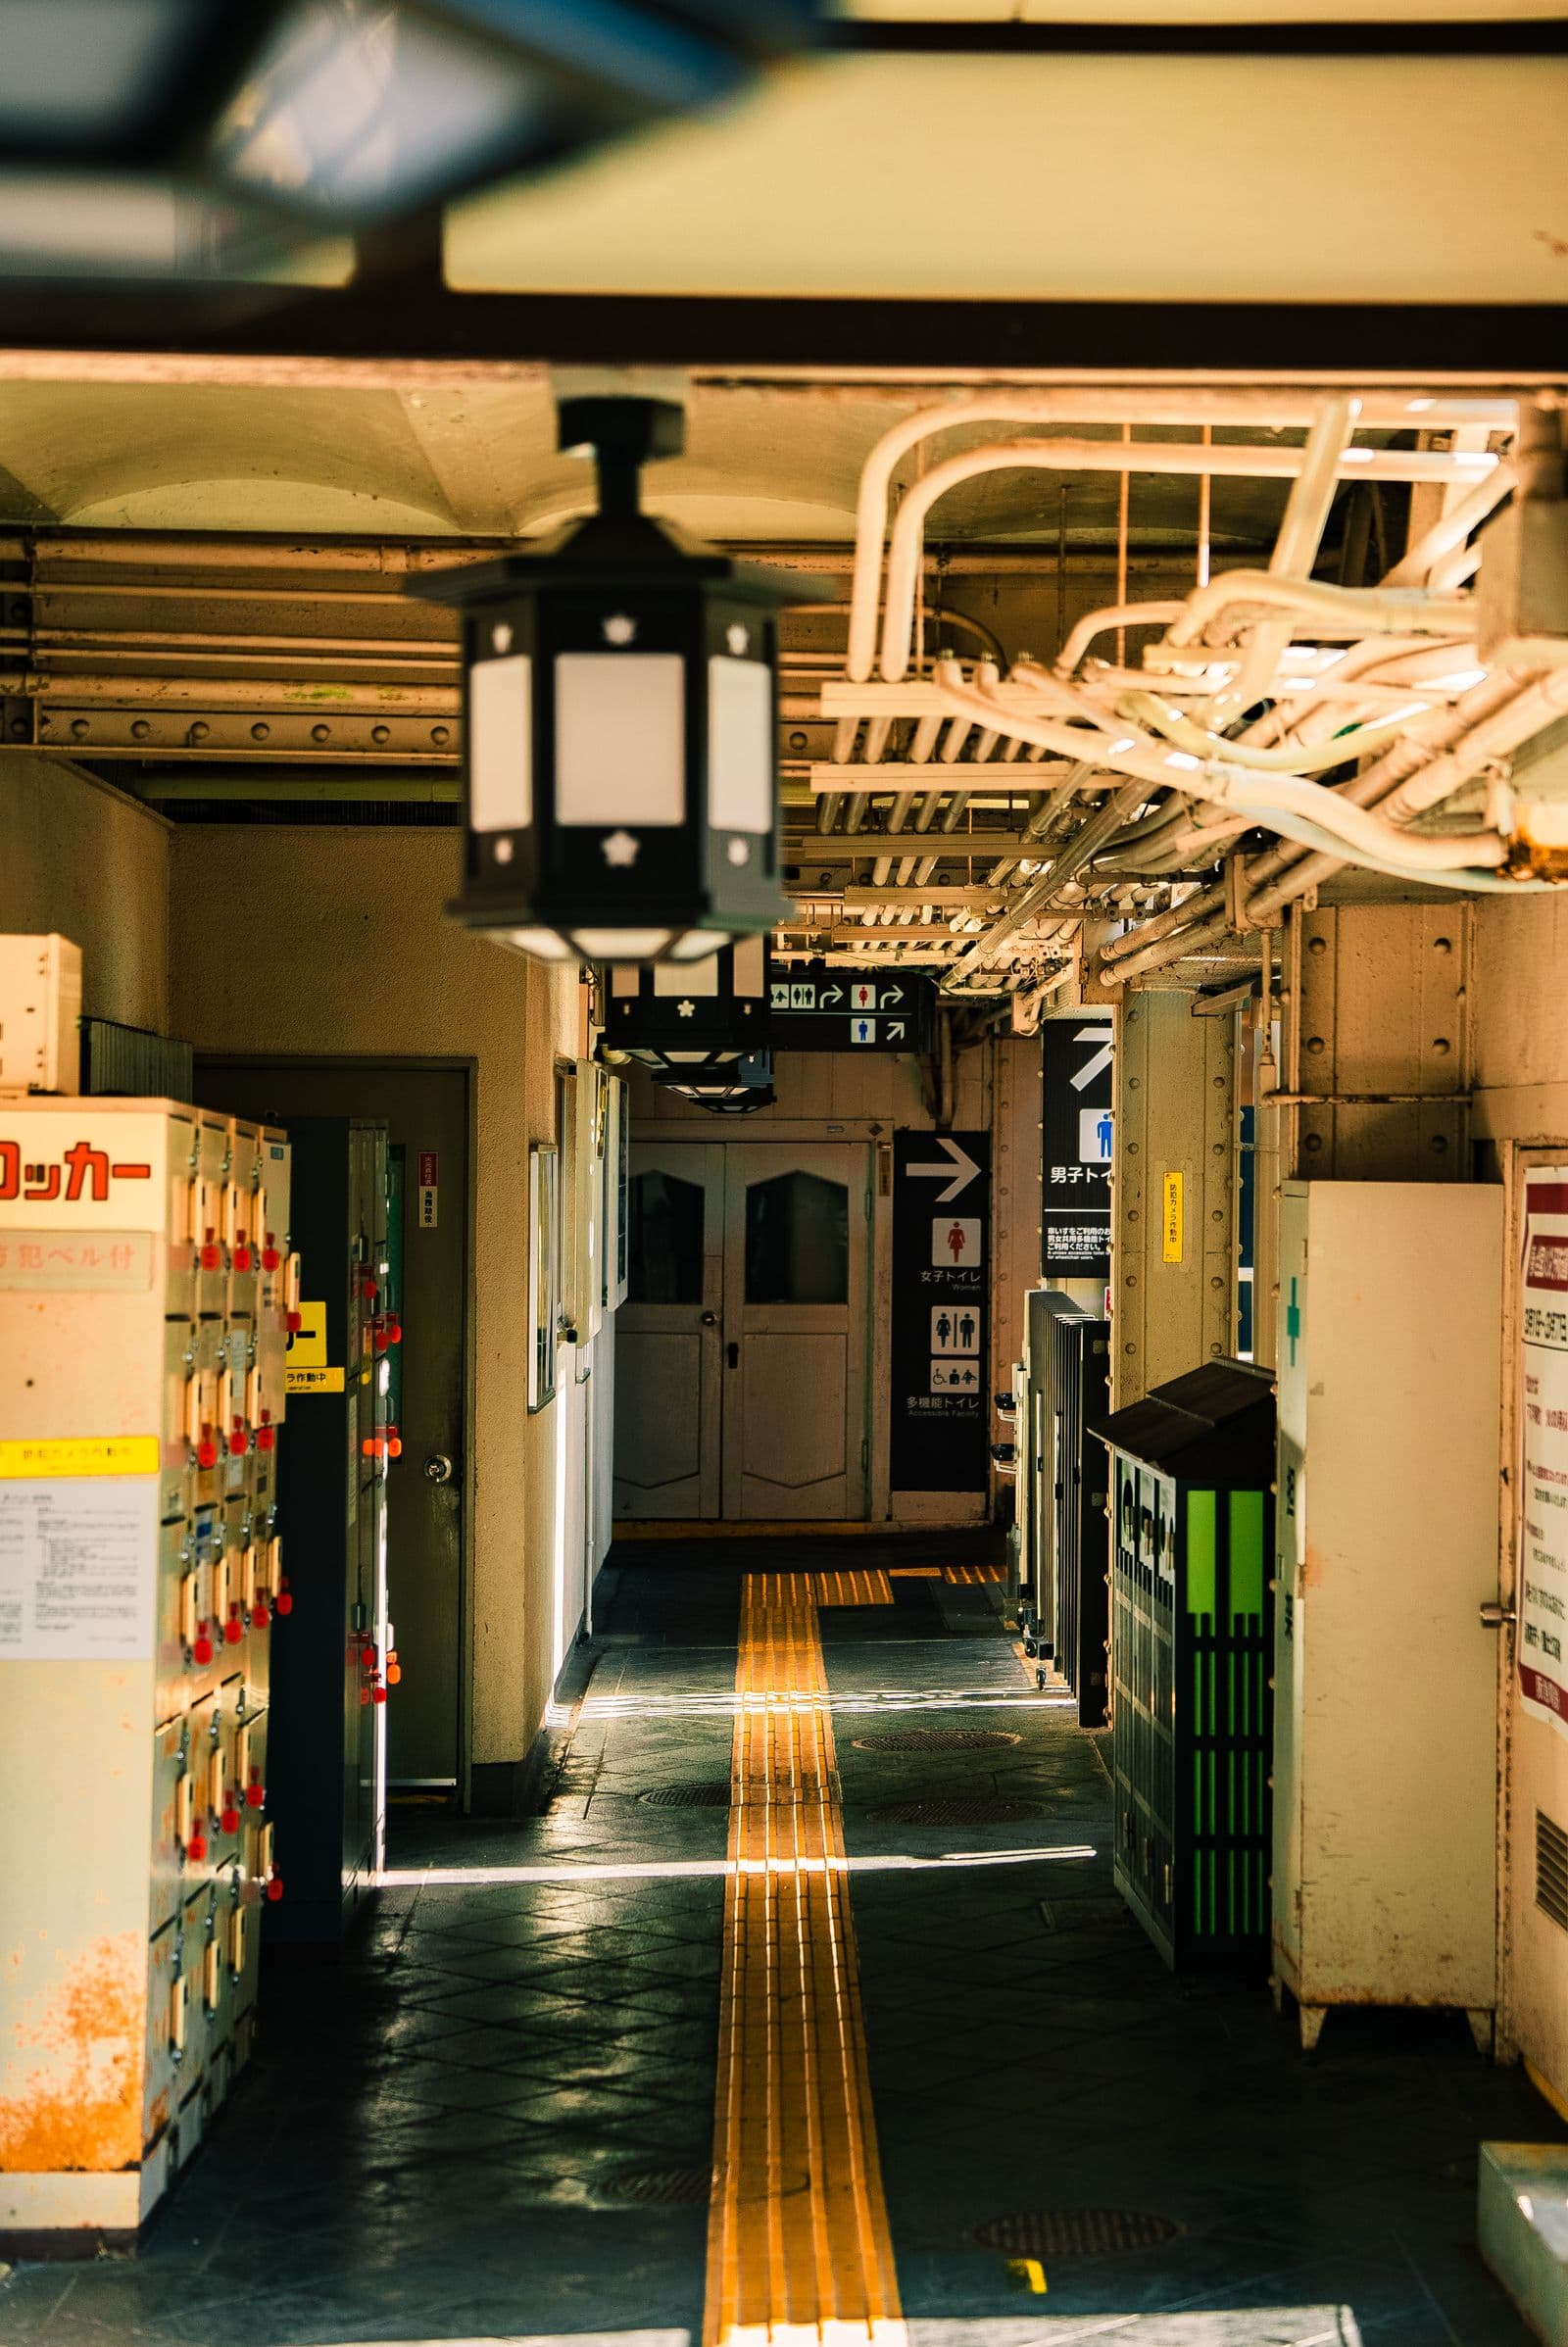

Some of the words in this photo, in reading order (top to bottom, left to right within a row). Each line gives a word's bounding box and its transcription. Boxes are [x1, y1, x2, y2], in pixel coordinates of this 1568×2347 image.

[920, 1270, 981, 1283] 女子トイレ
[906, 1396, 980, 1409] 多機能トイレ
